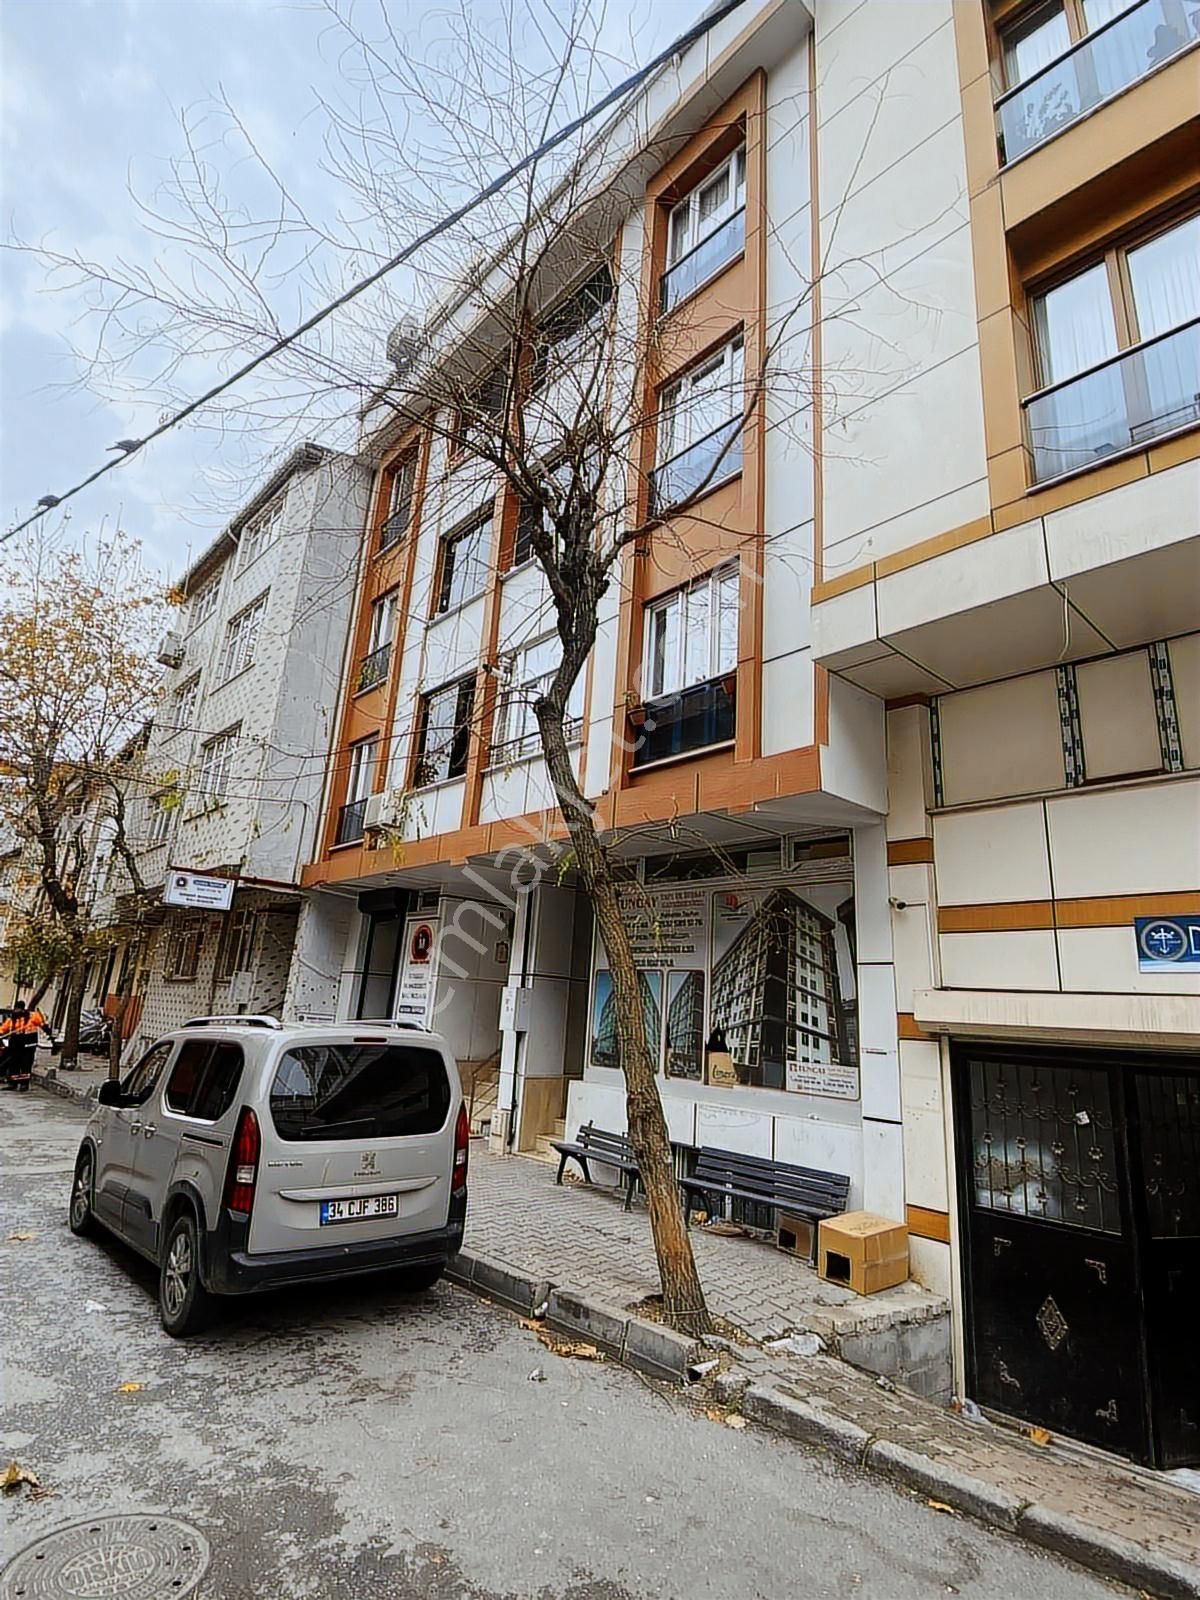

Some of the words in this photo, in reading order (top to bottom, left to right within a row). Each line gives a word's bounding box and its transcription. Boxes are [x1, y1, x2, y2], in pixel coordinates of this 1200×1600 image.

[328, 1202, 343, 1219] 34
[347, 1199, 369, 1216] CJF
[374, 1196, 395, 1213] 386
